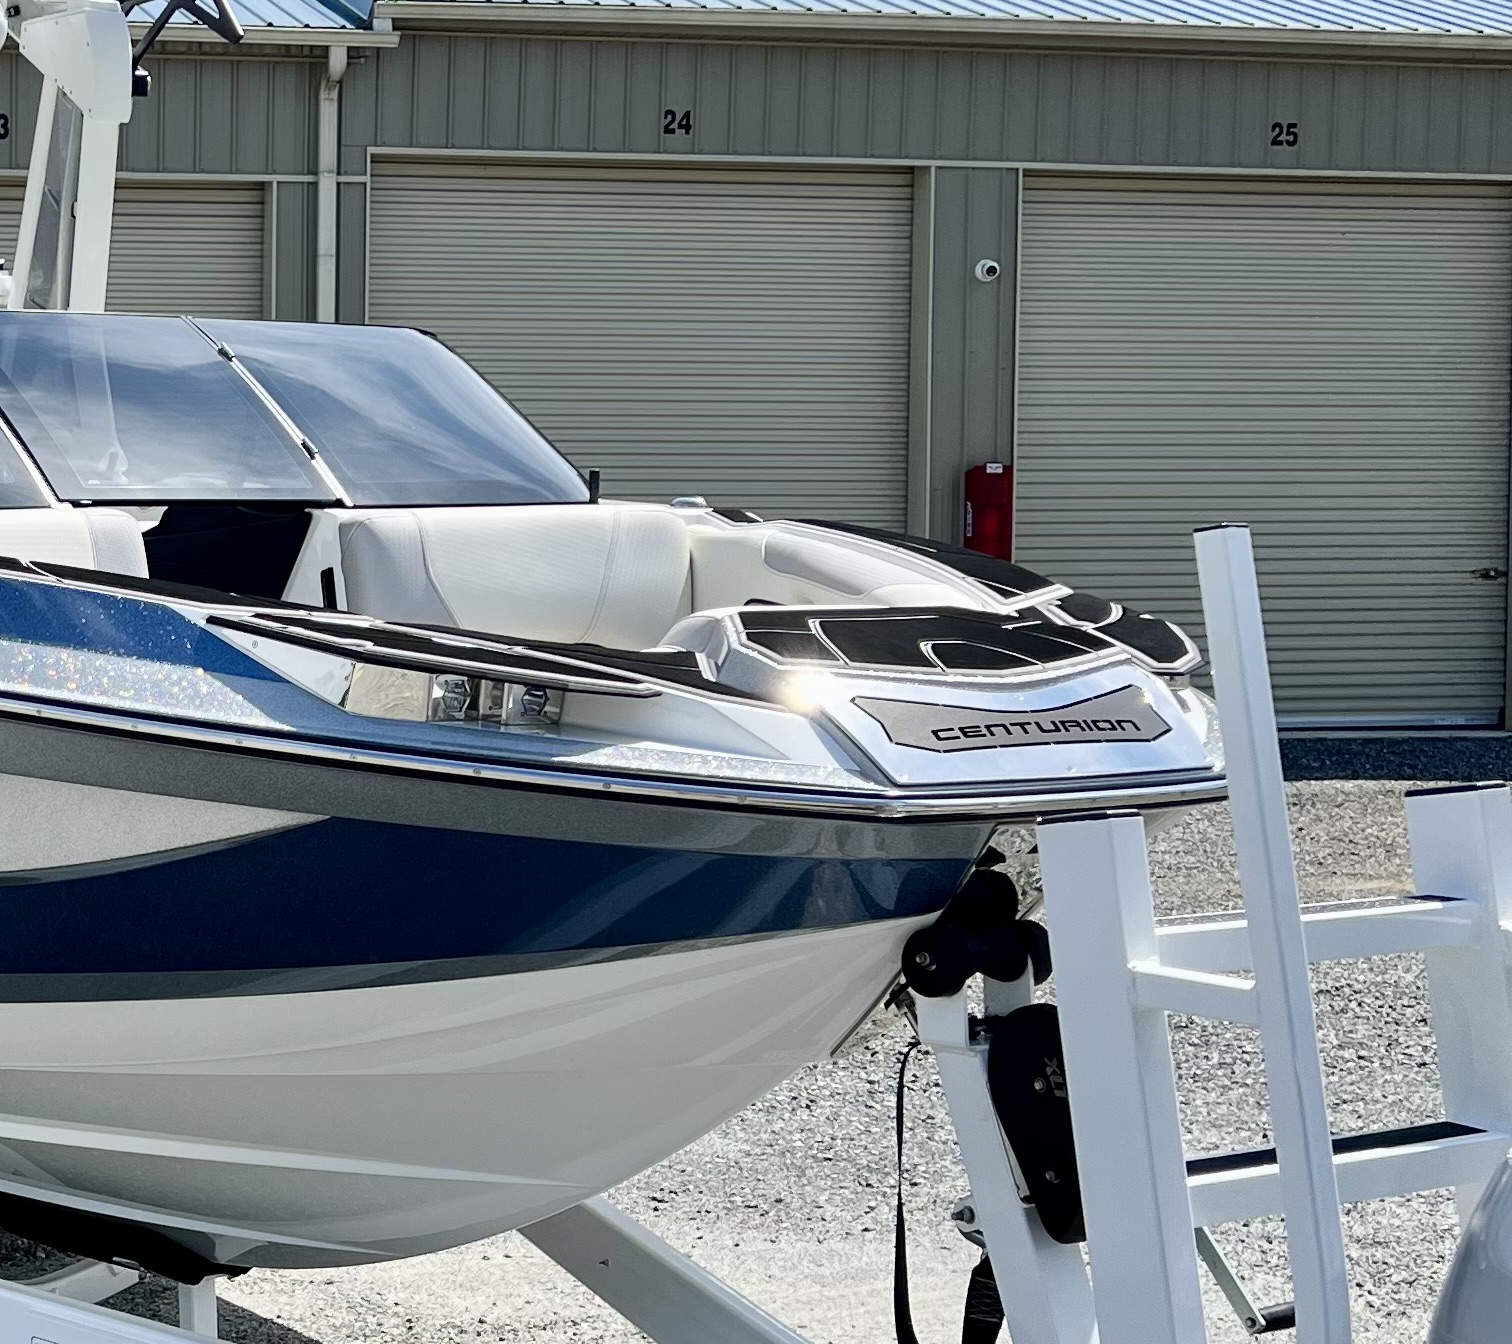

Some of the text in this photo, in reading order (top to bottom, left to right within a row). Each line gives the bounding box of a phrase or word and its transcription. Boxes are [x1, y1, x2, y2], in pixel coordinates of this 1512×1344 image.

[663, 109, 692, 136] 24
[1270, 121, 1299, 147] 25
[931, 719, 1142, 742] CENTURION
